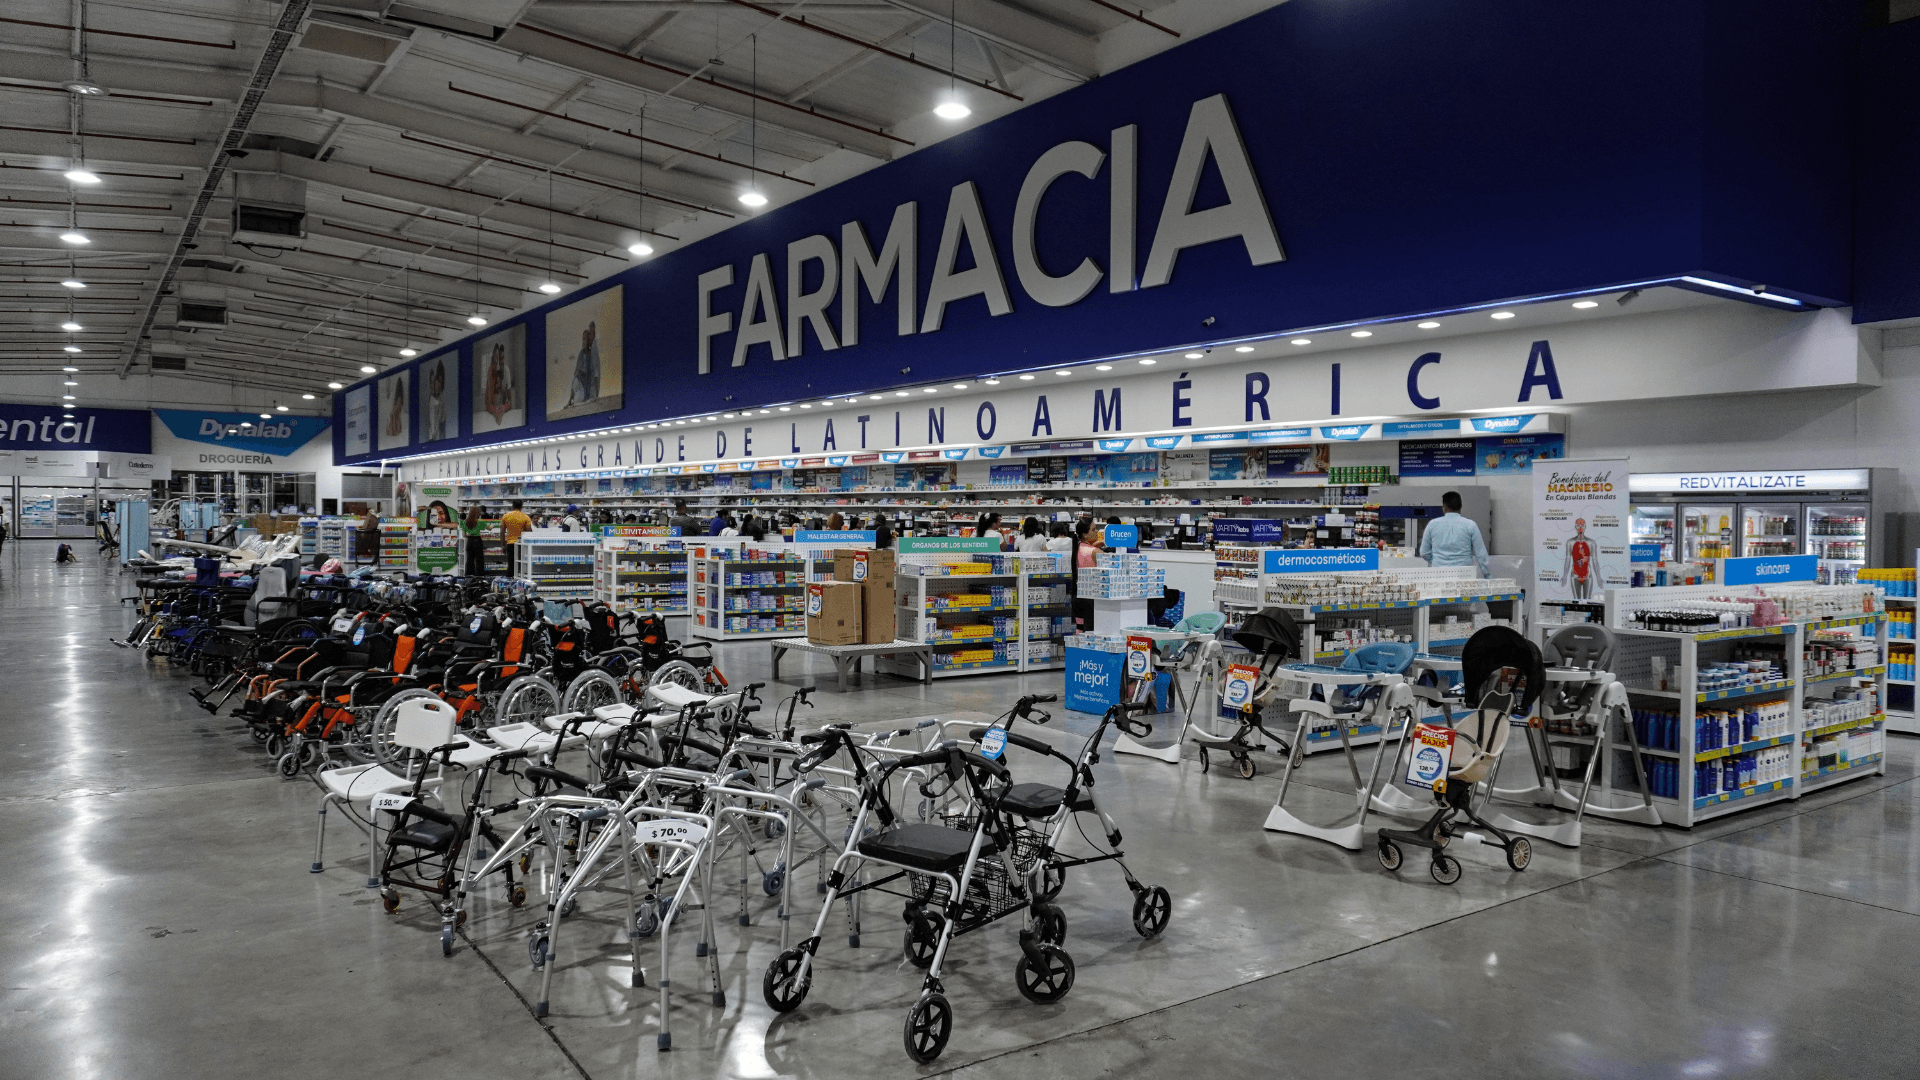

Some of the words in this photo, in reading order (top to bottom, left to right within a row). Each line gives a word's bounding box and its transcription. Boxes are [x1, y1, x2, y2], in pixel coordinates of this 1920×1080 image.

[698, 93, 1287, 375] FARMACIA
[414, 463, 427, 480] LA
[439, 454, 511, 478] FARMACIA
[527, 447, 561, 473] MÁS
[580, 435, 685, 468] GRANDE
[716, 427, 752, 459] DE
[791, 340, 1564, 453] LATINOAMÉRICA
[199, 419, 291, 440] Dynalab
[1484, 418, 1519, 430] Dynalab
[1331, 427, 1359, 437] Dynalab
[1106, 440, 1125, 449] Dynalab
[1153, 437, 1174, 446] Dynalab
[1439, 441, 1473, 449] ESPECÍFICOS
[200, 454, 273, 465] DROGUERÍA
[1550, 471, 1592, 486] Beneficios
[1594, 470, 1612, 483] del
[1680, 475, 1806, 489] REDVITALIZATE
[1547, 483, 1613, 493] MAGNESIO
[1556, 493, 1586, 502] Cápsulas
[1110, 529, 1132, 538] Brucen
[911, 541, 940, 549] ÓRGANOS
[1277, 552, 1366, 566] dermocosméticos
[1755, 562, 1791, 576] skincare
[1079, 659, 1098, 671] ¡Más
[1098, 663, 1104, 673] y
[1074, 670, 1109, 688] mejor!
[1421, 730, 1448, 741] PRECIOS
[1421, 737, 1446, 748] BAJOS
[651, 830, 658, 838] $
